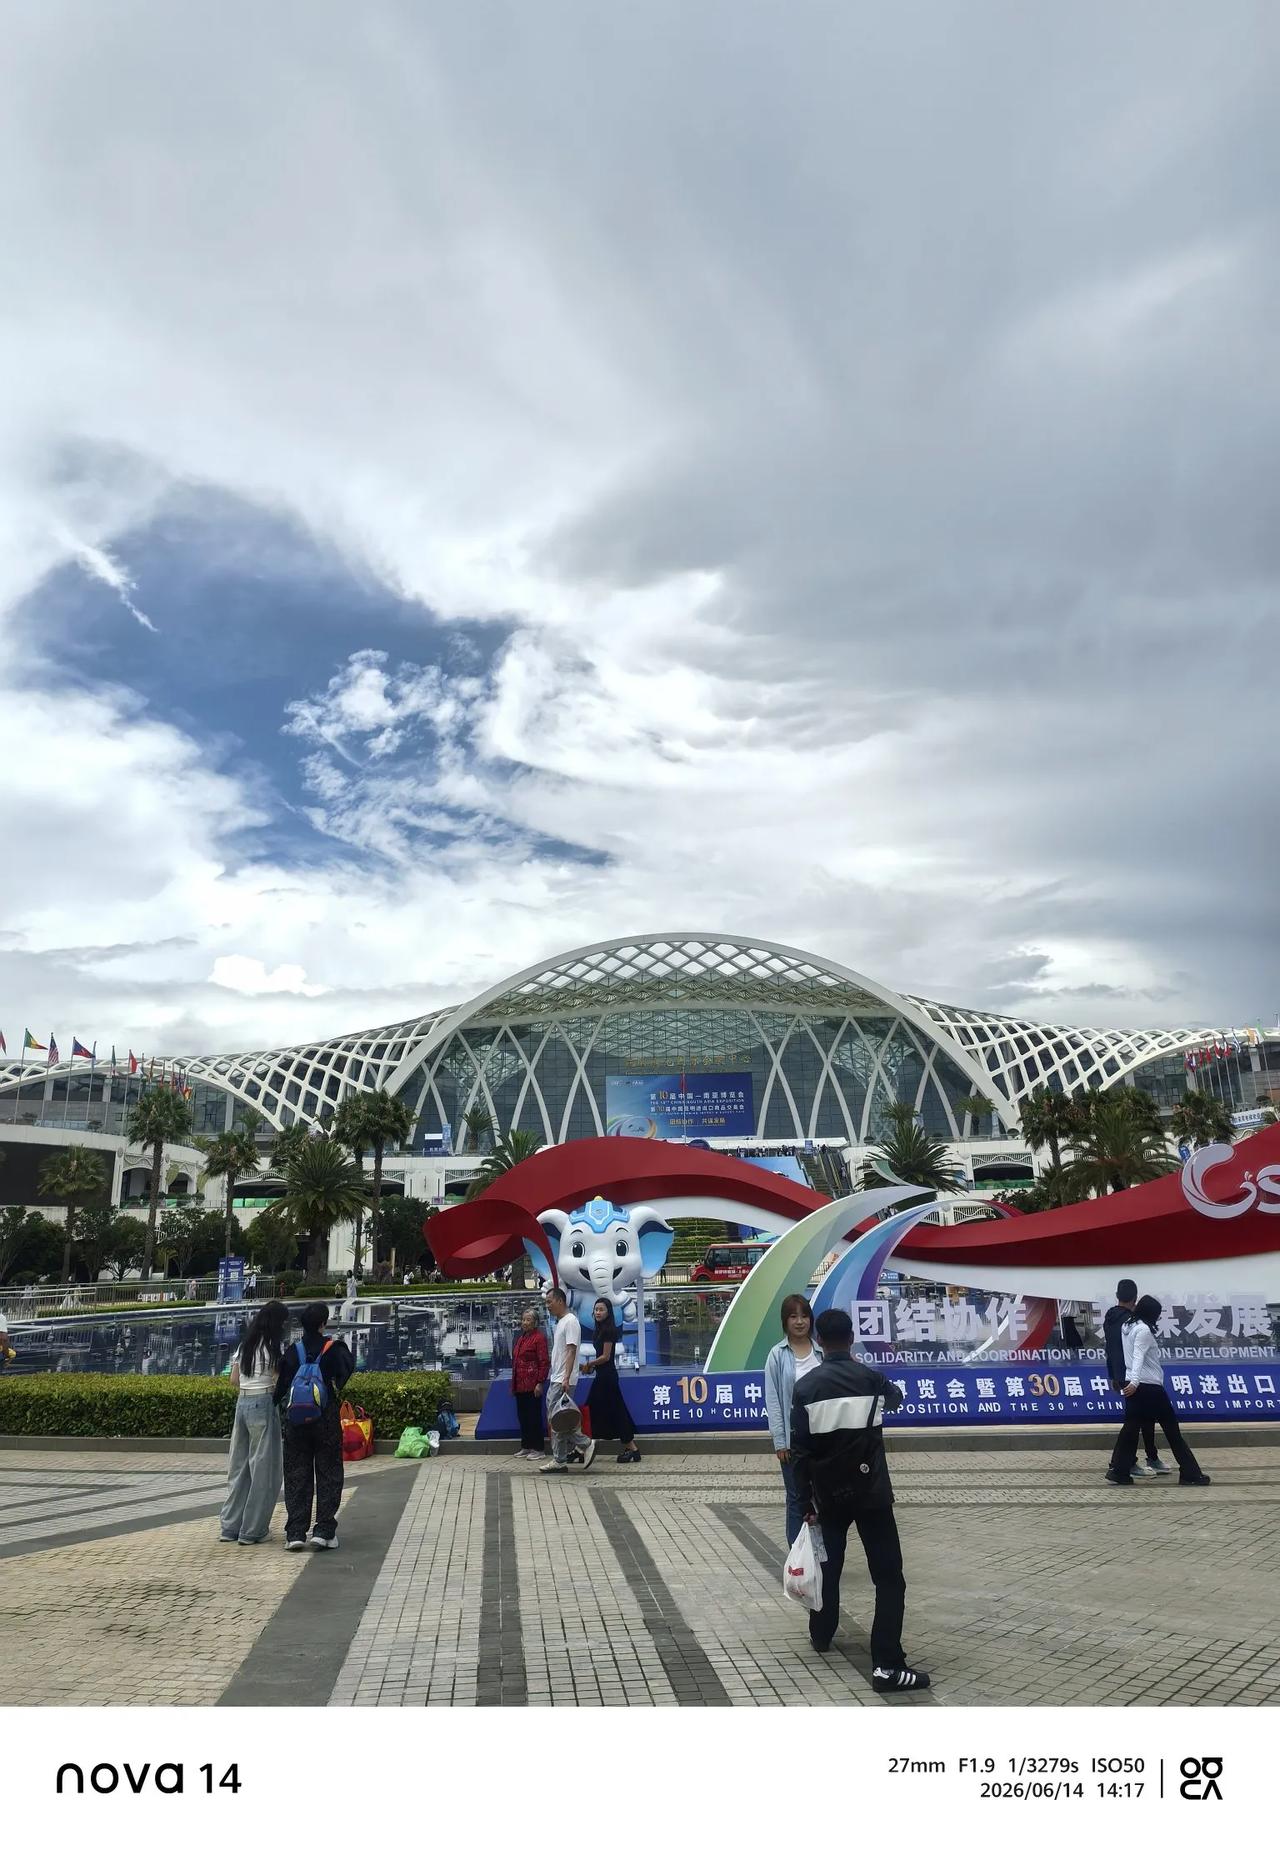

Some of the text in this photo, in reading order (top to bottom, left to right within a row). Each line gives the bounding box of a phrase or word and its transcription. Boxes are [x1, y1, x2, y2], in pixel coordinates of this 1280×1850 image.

[851, 1297, 1028, 1342] 团结协作
[856, 1350, 934, 1364] SOLIDARITY
[938, 1350, 965, 1362] AND
[970, 1348, 1070, 1362] COORDINATION
[1078, 1348, 1106, 1360] FOR
[1174, 1346, 1276, 1359] DEVELOPMENT
[652, 1409, 681, 1420] THE
[723, 1407, 768, 1418] CHINA
[881, 1402, 969, 1415] POSITION
[978, 1402, 1001, 1413] AND
[1010, 1402, 1039, 1411] THE
[1086, 1401, 1124, 1410] CHIN
